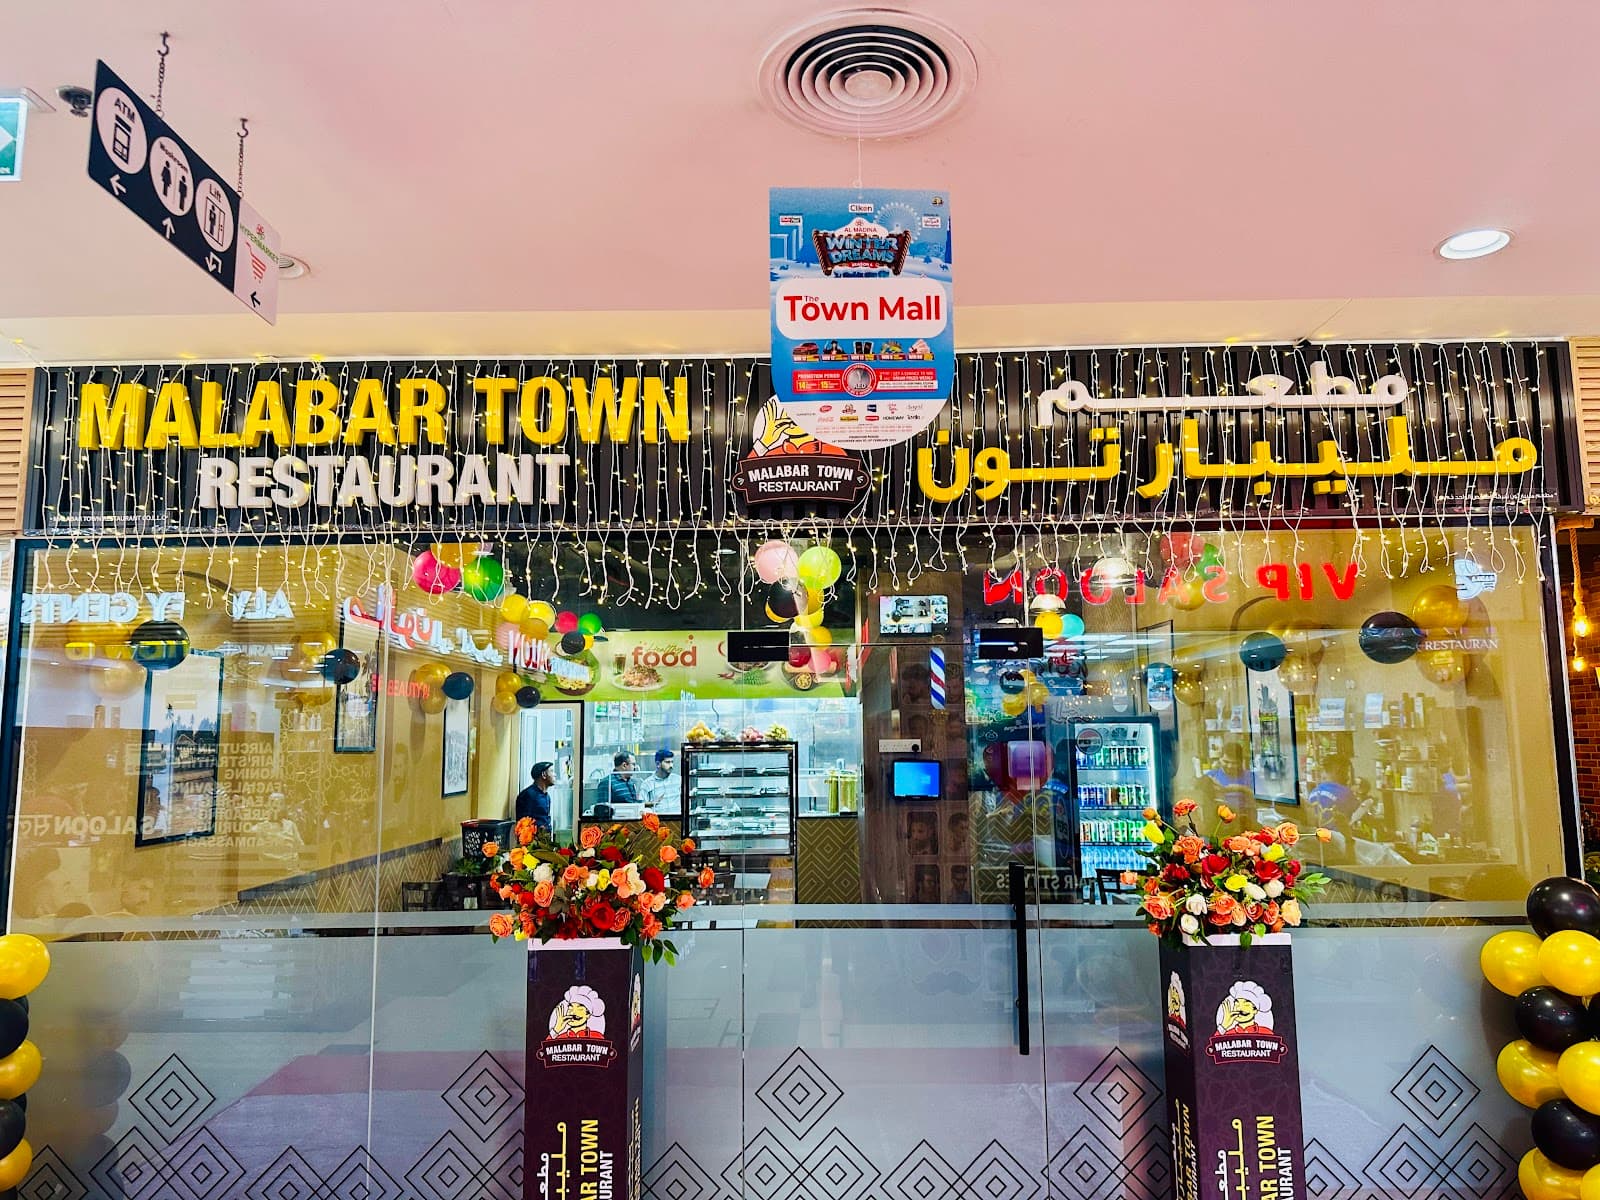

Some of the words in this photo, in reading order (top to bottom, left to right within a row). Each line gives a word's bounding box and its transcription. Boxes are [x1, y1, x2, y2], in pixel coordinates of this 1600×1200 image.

[114, 97, 136, 124] ATM
[209, 184, 222, 203] Lift
[825, 236, 899, 250] WINTER
[830, 249, 896, 264] DREAMS
[783, 295, 869, 322] Town
[879, 295, 941, 321] Mall
[1036, 361, 1409, 428] مطعم
[78, 377, 446, 450] MALABAR
[475, 376, 690, 445] TOWN
[748, 464, 810, 483] MALABAR
[817, 464, 854, 482] TOWN
[917, 427, 1120, 504] تون
[198, 453, 571, 509] RESTAURANT
[758, 480, 842, 493] RESTAURANT
[52, 515, 82, 523] MABAR
[632, 645, 697, 667] food
[545, 1043, 583, 1055] MALABAR
[586, 1043, 609, 1055] TOWN
[1215, 1039, 1252, 1051] MALABAR
[1256, 1039, 1278, 1051] TOWN
[1221, 1049, 1272, 1058] RESTAURANT
[551, 1053, 601, 1063] RESTAURANT
[580, 1119, 599, 1177] TOWN
[1256, 1115, 1277, 1173] TOWN
